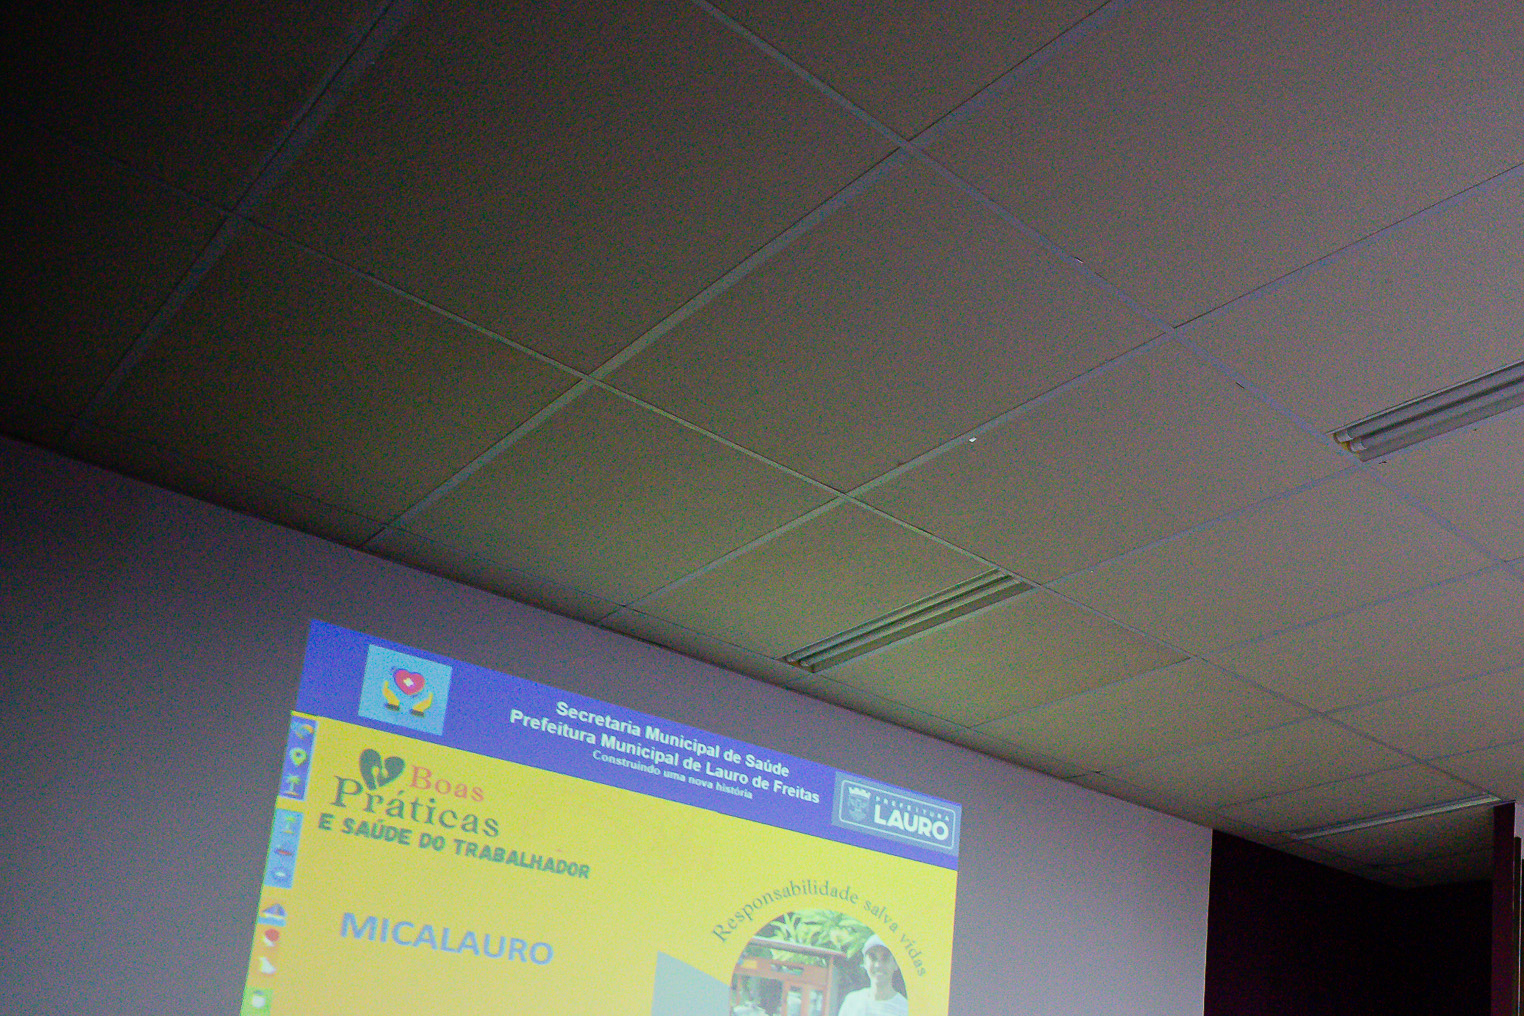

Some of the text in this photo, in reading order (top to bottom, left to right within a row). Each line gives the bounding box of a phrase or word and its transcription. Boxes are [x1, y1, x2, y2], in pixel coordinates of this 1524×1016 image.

[509, 708, 820, 804] Prefeitura Municipal de Lauro de Freitas
[556, 701, 790, 778] Secretaria Municipal de Saúde
[409, 765, 485, 802] Boas
[592, 749, 753, 800] Construindo uma nova história
[330, 775, 500, 838] Práticas
[874, 804, 949, 841] LAURO
[318, 812, 591, 879] E SAÚDE DO TRABALHADOR
[340, 912, 554, 965] MICALAURO
[712, 879, 927, 977] Responsabilidade salva vidas
